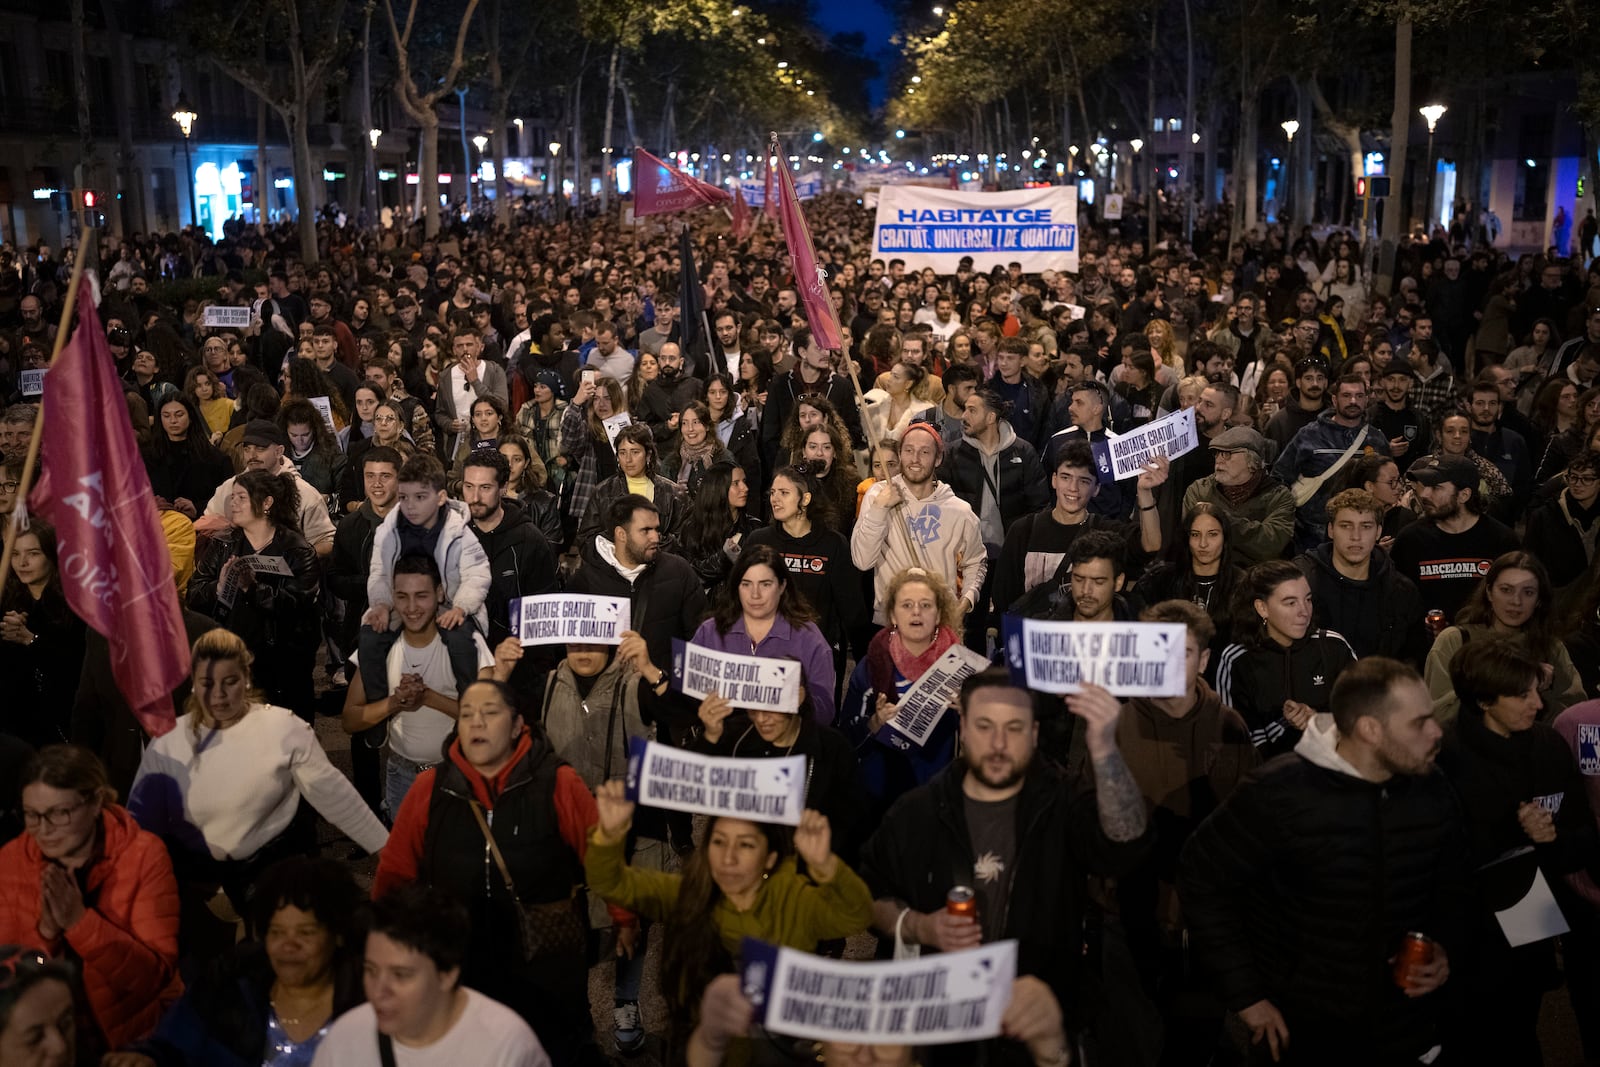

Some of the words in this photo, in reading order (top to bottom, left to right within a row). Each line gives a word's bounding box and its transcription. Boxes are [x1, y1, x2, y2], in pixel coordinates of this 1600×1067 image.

[898, 209, 1053, 223] HABITATGE
[934, 228, 992, 248] UNIVERSAL
[996, 228, 1001, 248] I
[1004, 228, 1019, 248] DE
[1113, 433, 1148, 459] HABITATGE
[1116, 450, 1154, 475] UNIVERSAL
[784, 557, 809, 568] VAL
[1420, 563, 1477, 575] BARCELONA
[525, 601, 560, 620] HABITATGE
[562, 599, 597, 619] GRATUÏT,
[524, 620, 560, 640] UNIVERSAL
[567, 620, 579, 637] DE
[580, 621, 616, 638] QUALITAT
[688, 651, 722, 678] HABITATGE
[724, 661, 761, 684] GRATUÏT,
[1116, 662, 1166, 687] QUALITAT
[728, 683, 739, 701] DE
[741, 684, 783, 705] QUALITAT
[895, 690, 929, 730] HABITATGE
[908, 698, 944, 738] UNIVERSAL
[937, 686, 953, 700] DE
[650, 754, 706, 785] HABITATGE
[648, 779, 706, 807] UNIVERSAL
[718, 790, 731, 809] DE
[735, 792, 787, 816] QUALITAT
